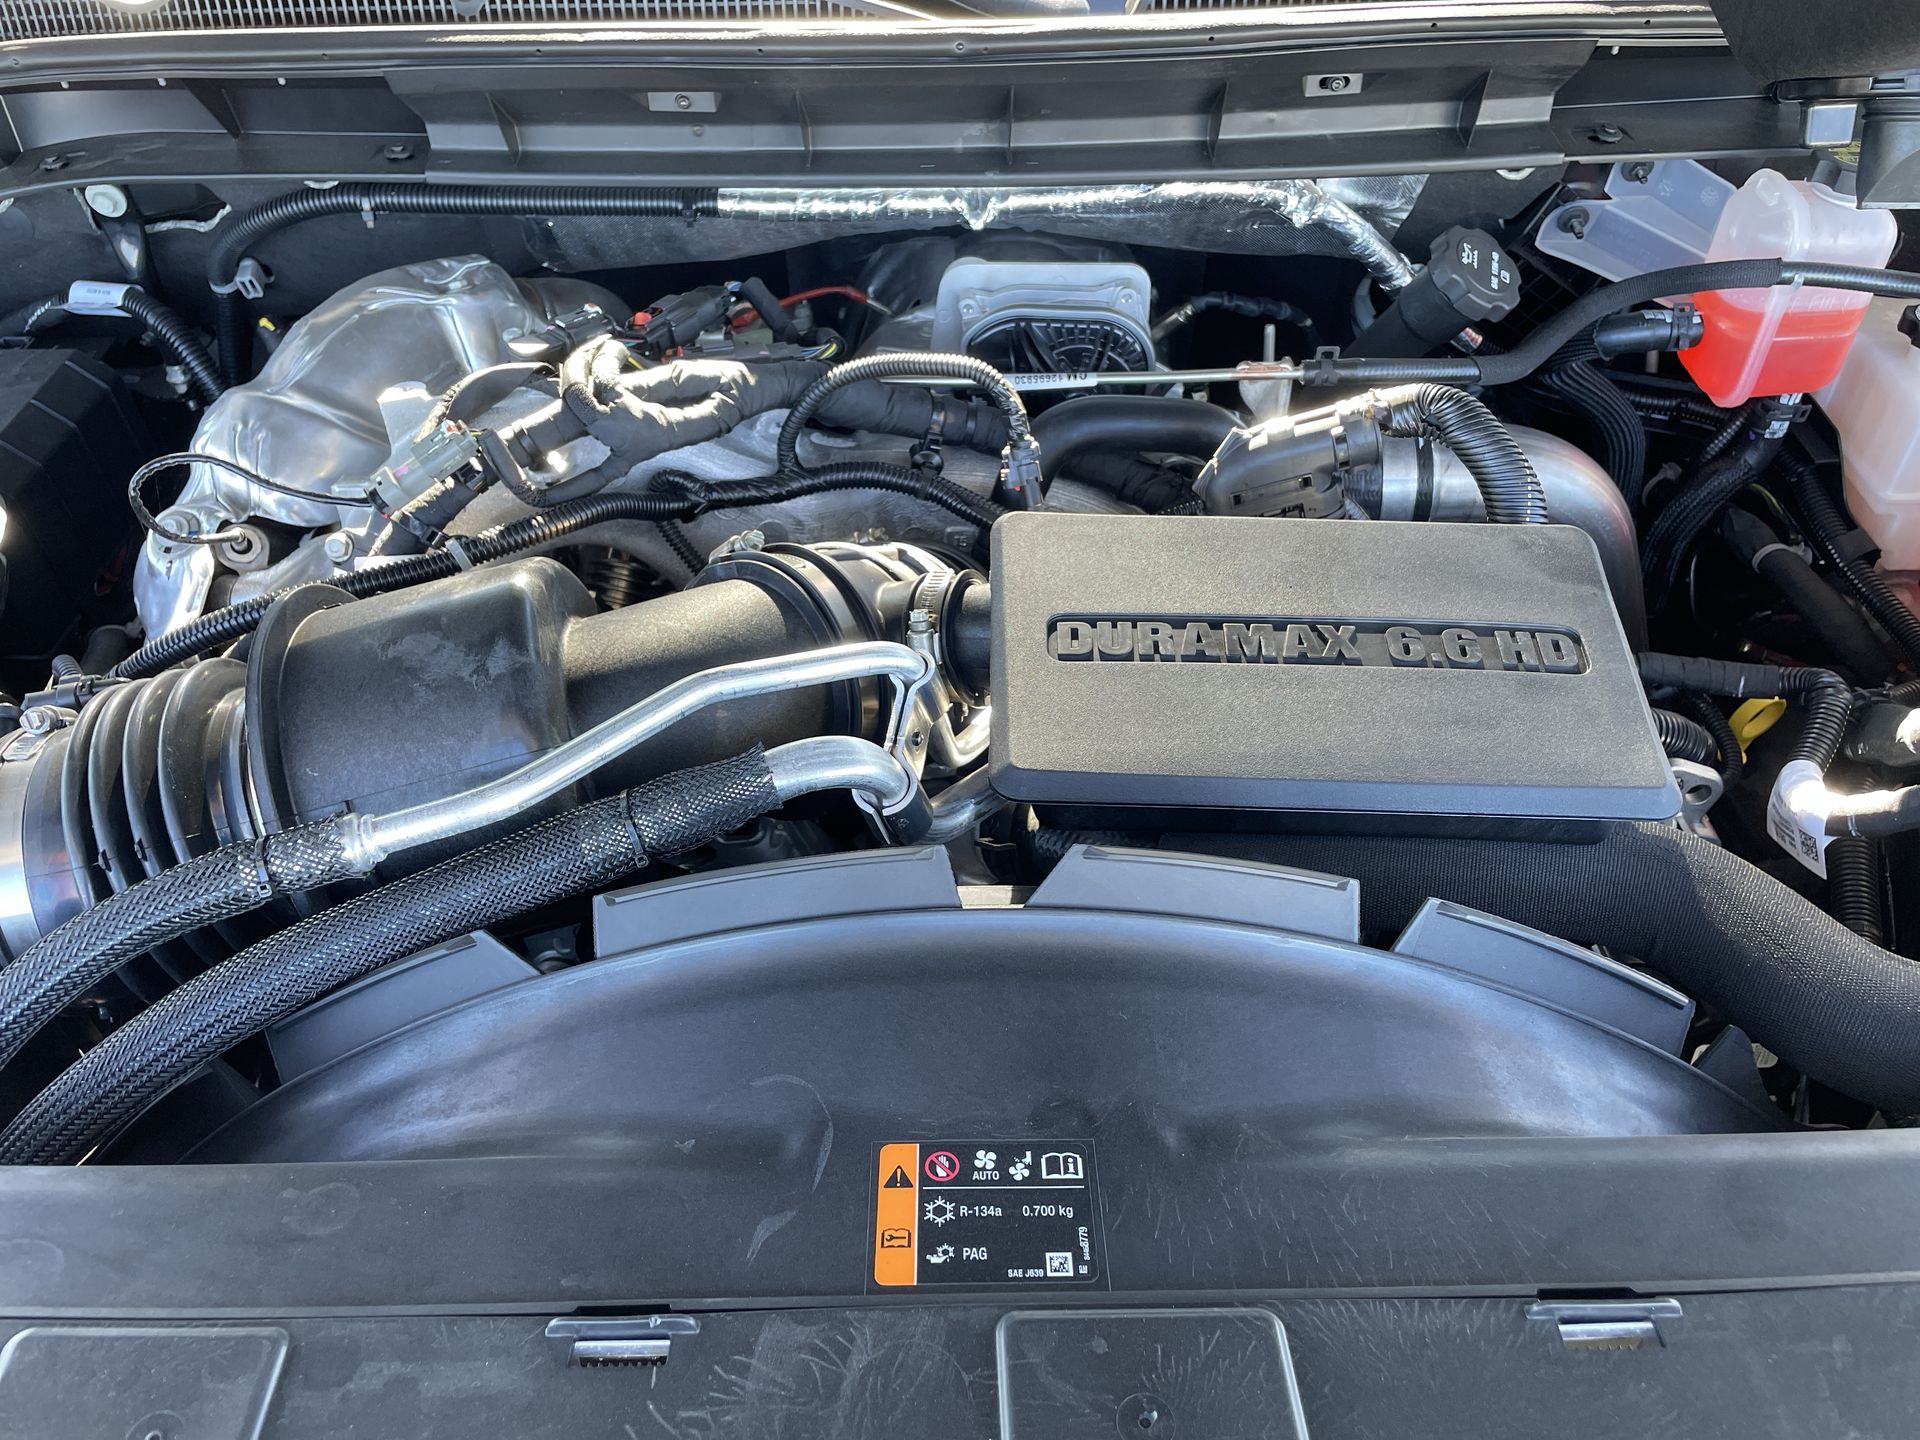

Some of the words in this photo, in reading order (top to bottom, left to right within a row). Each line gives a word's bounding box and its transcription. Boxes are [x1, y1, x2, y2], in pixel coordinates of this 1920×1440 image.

[1056, 621, 1360, 662] DURAMAX
[1385, 626, 1481, 666] 6.6
[1494, 630, 1579, 670] HD
[972, 1170, 1000, 1181] AUTO
[959, 1205, 1002, 1217] R-134a
[1022, 1205, 1056, 1217] 0.700
[1058, 1205, 1074, 1219] kg
[962, 1247, 988, 1260] PAG
[1007, 1268, 1024, 1278] SAE
